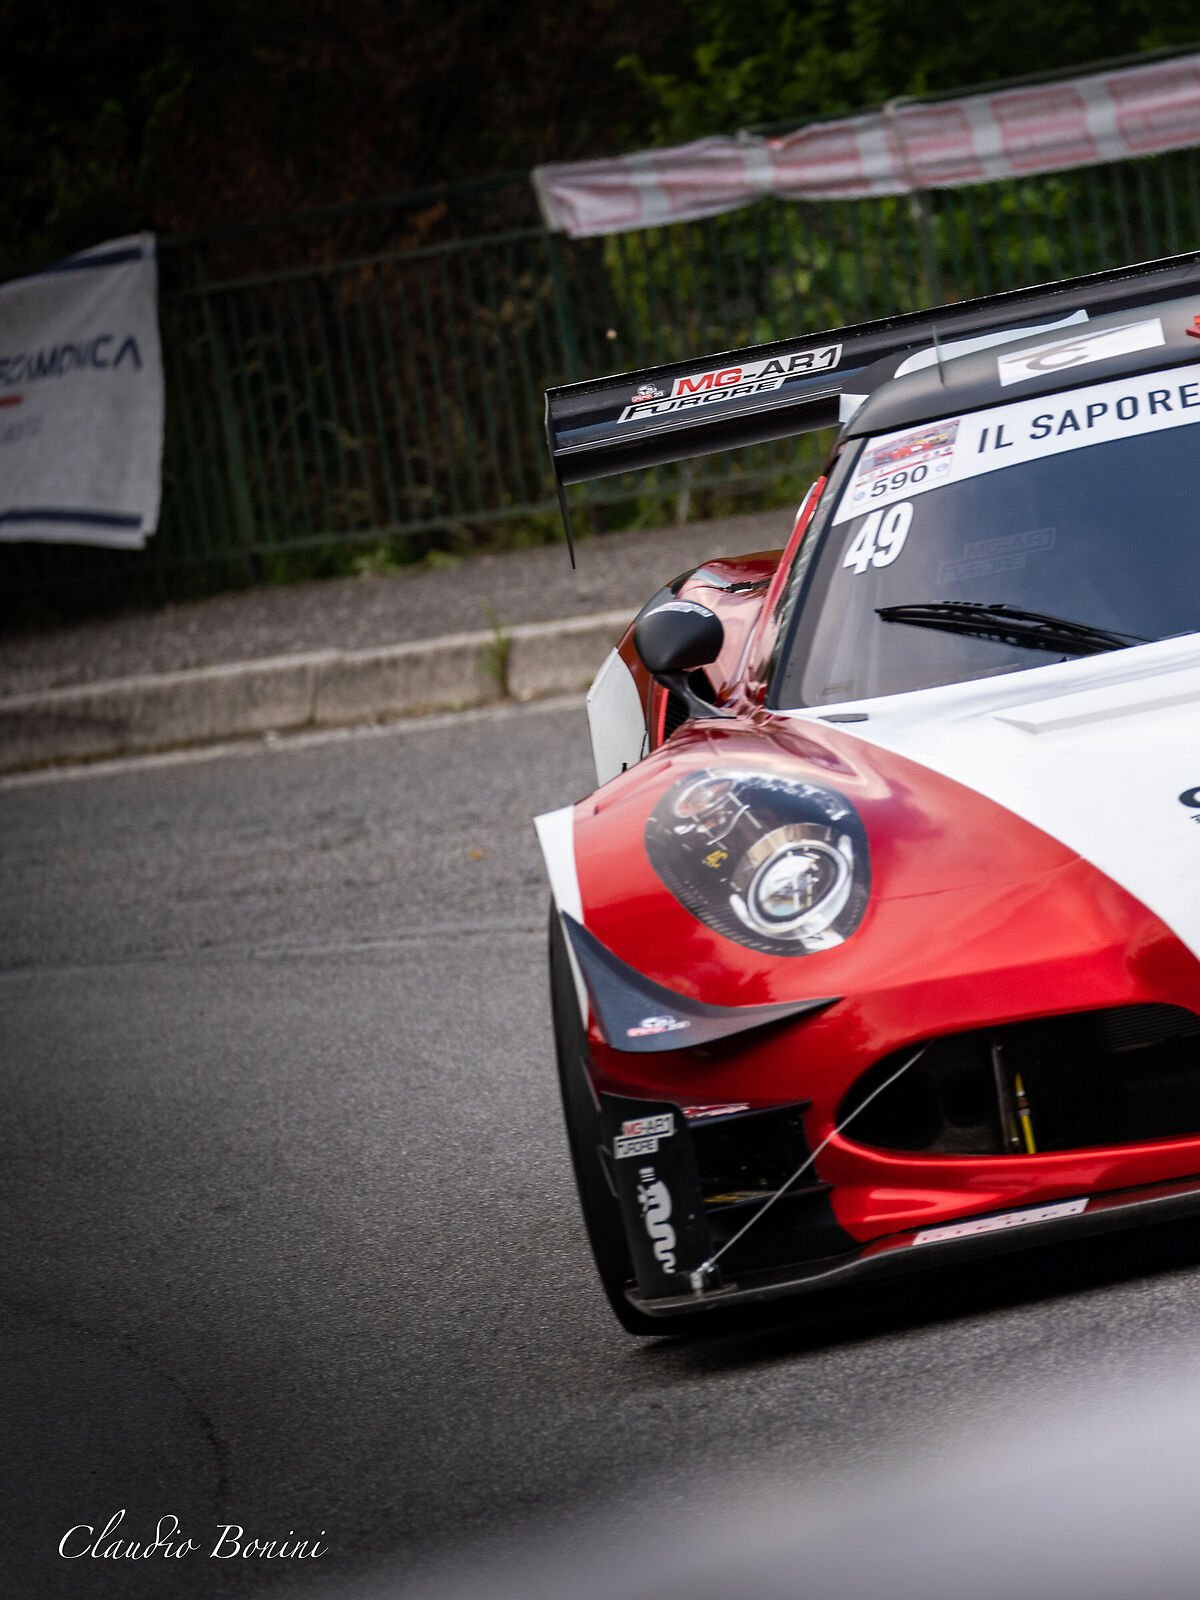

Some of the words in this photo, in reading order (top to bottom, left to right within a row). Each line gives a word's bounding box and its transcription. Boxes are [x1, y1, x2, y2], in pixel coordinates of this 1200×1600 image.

[676, 347, 838, 396] MG-AR1
[624, 379, 778, 420] FURORE
[978, 424, 1014, 454] IL
[870, 464, 928, 498] 590
[842, 500, 915, 575] 49
